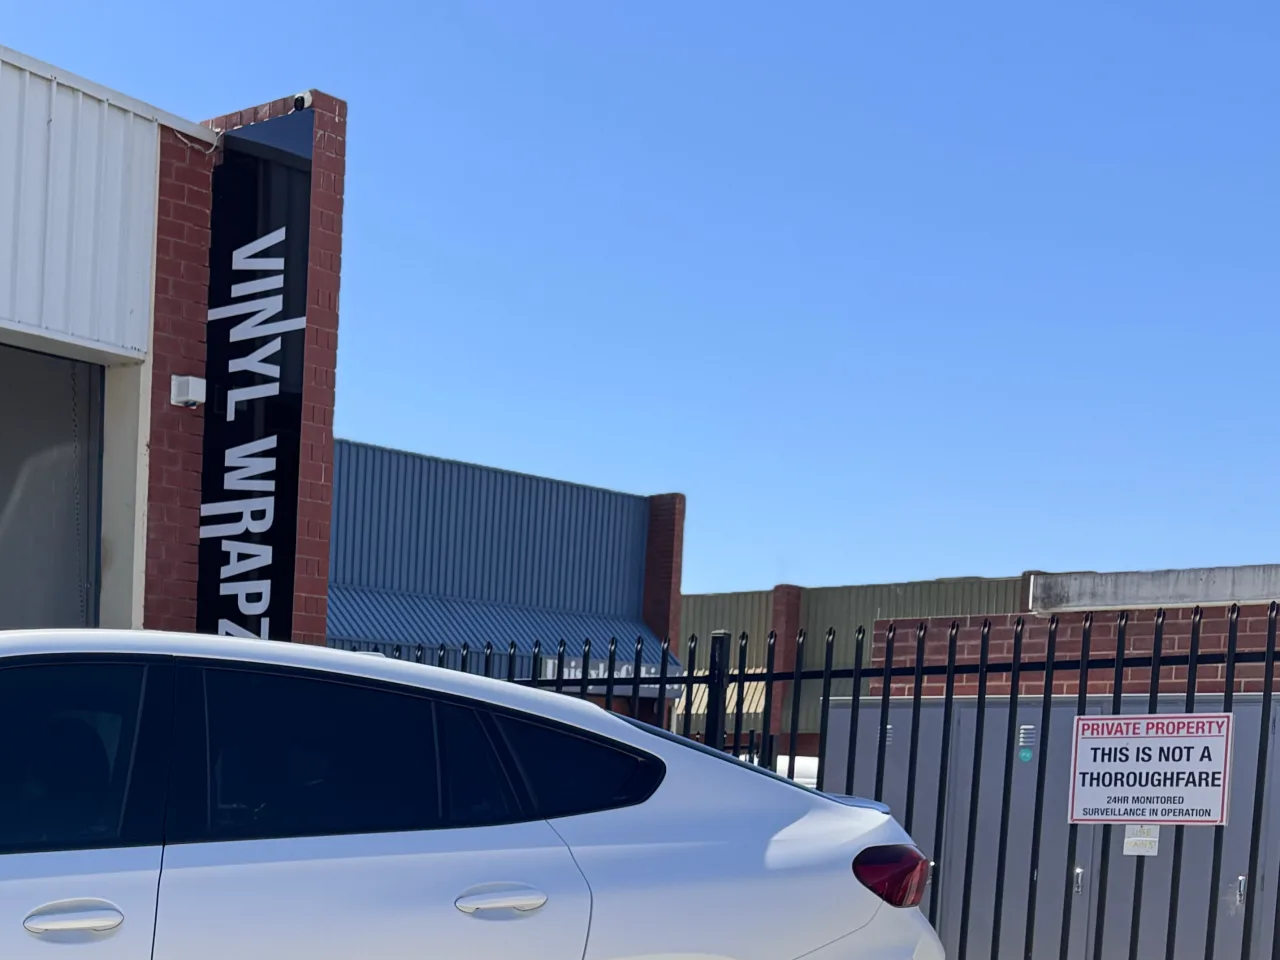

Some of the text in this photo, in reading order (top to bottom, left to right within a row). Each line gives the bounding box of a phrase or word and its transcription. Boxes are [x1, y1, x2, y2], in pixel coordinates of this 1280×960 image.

[208, 226, 307, 422] VINYL
[1081, 720, 1225, 736] PRIVATE PROPERTY
[1090, 746, 1212, 763] THIS IS NOT A
[1079, 771, 1222, 788] THOROUGHFARE
[1106, 796, 1184, 805] 24HR MONITORED
[1082, 807, 1212, 817] SURVEILLANCE IN OPERATION
